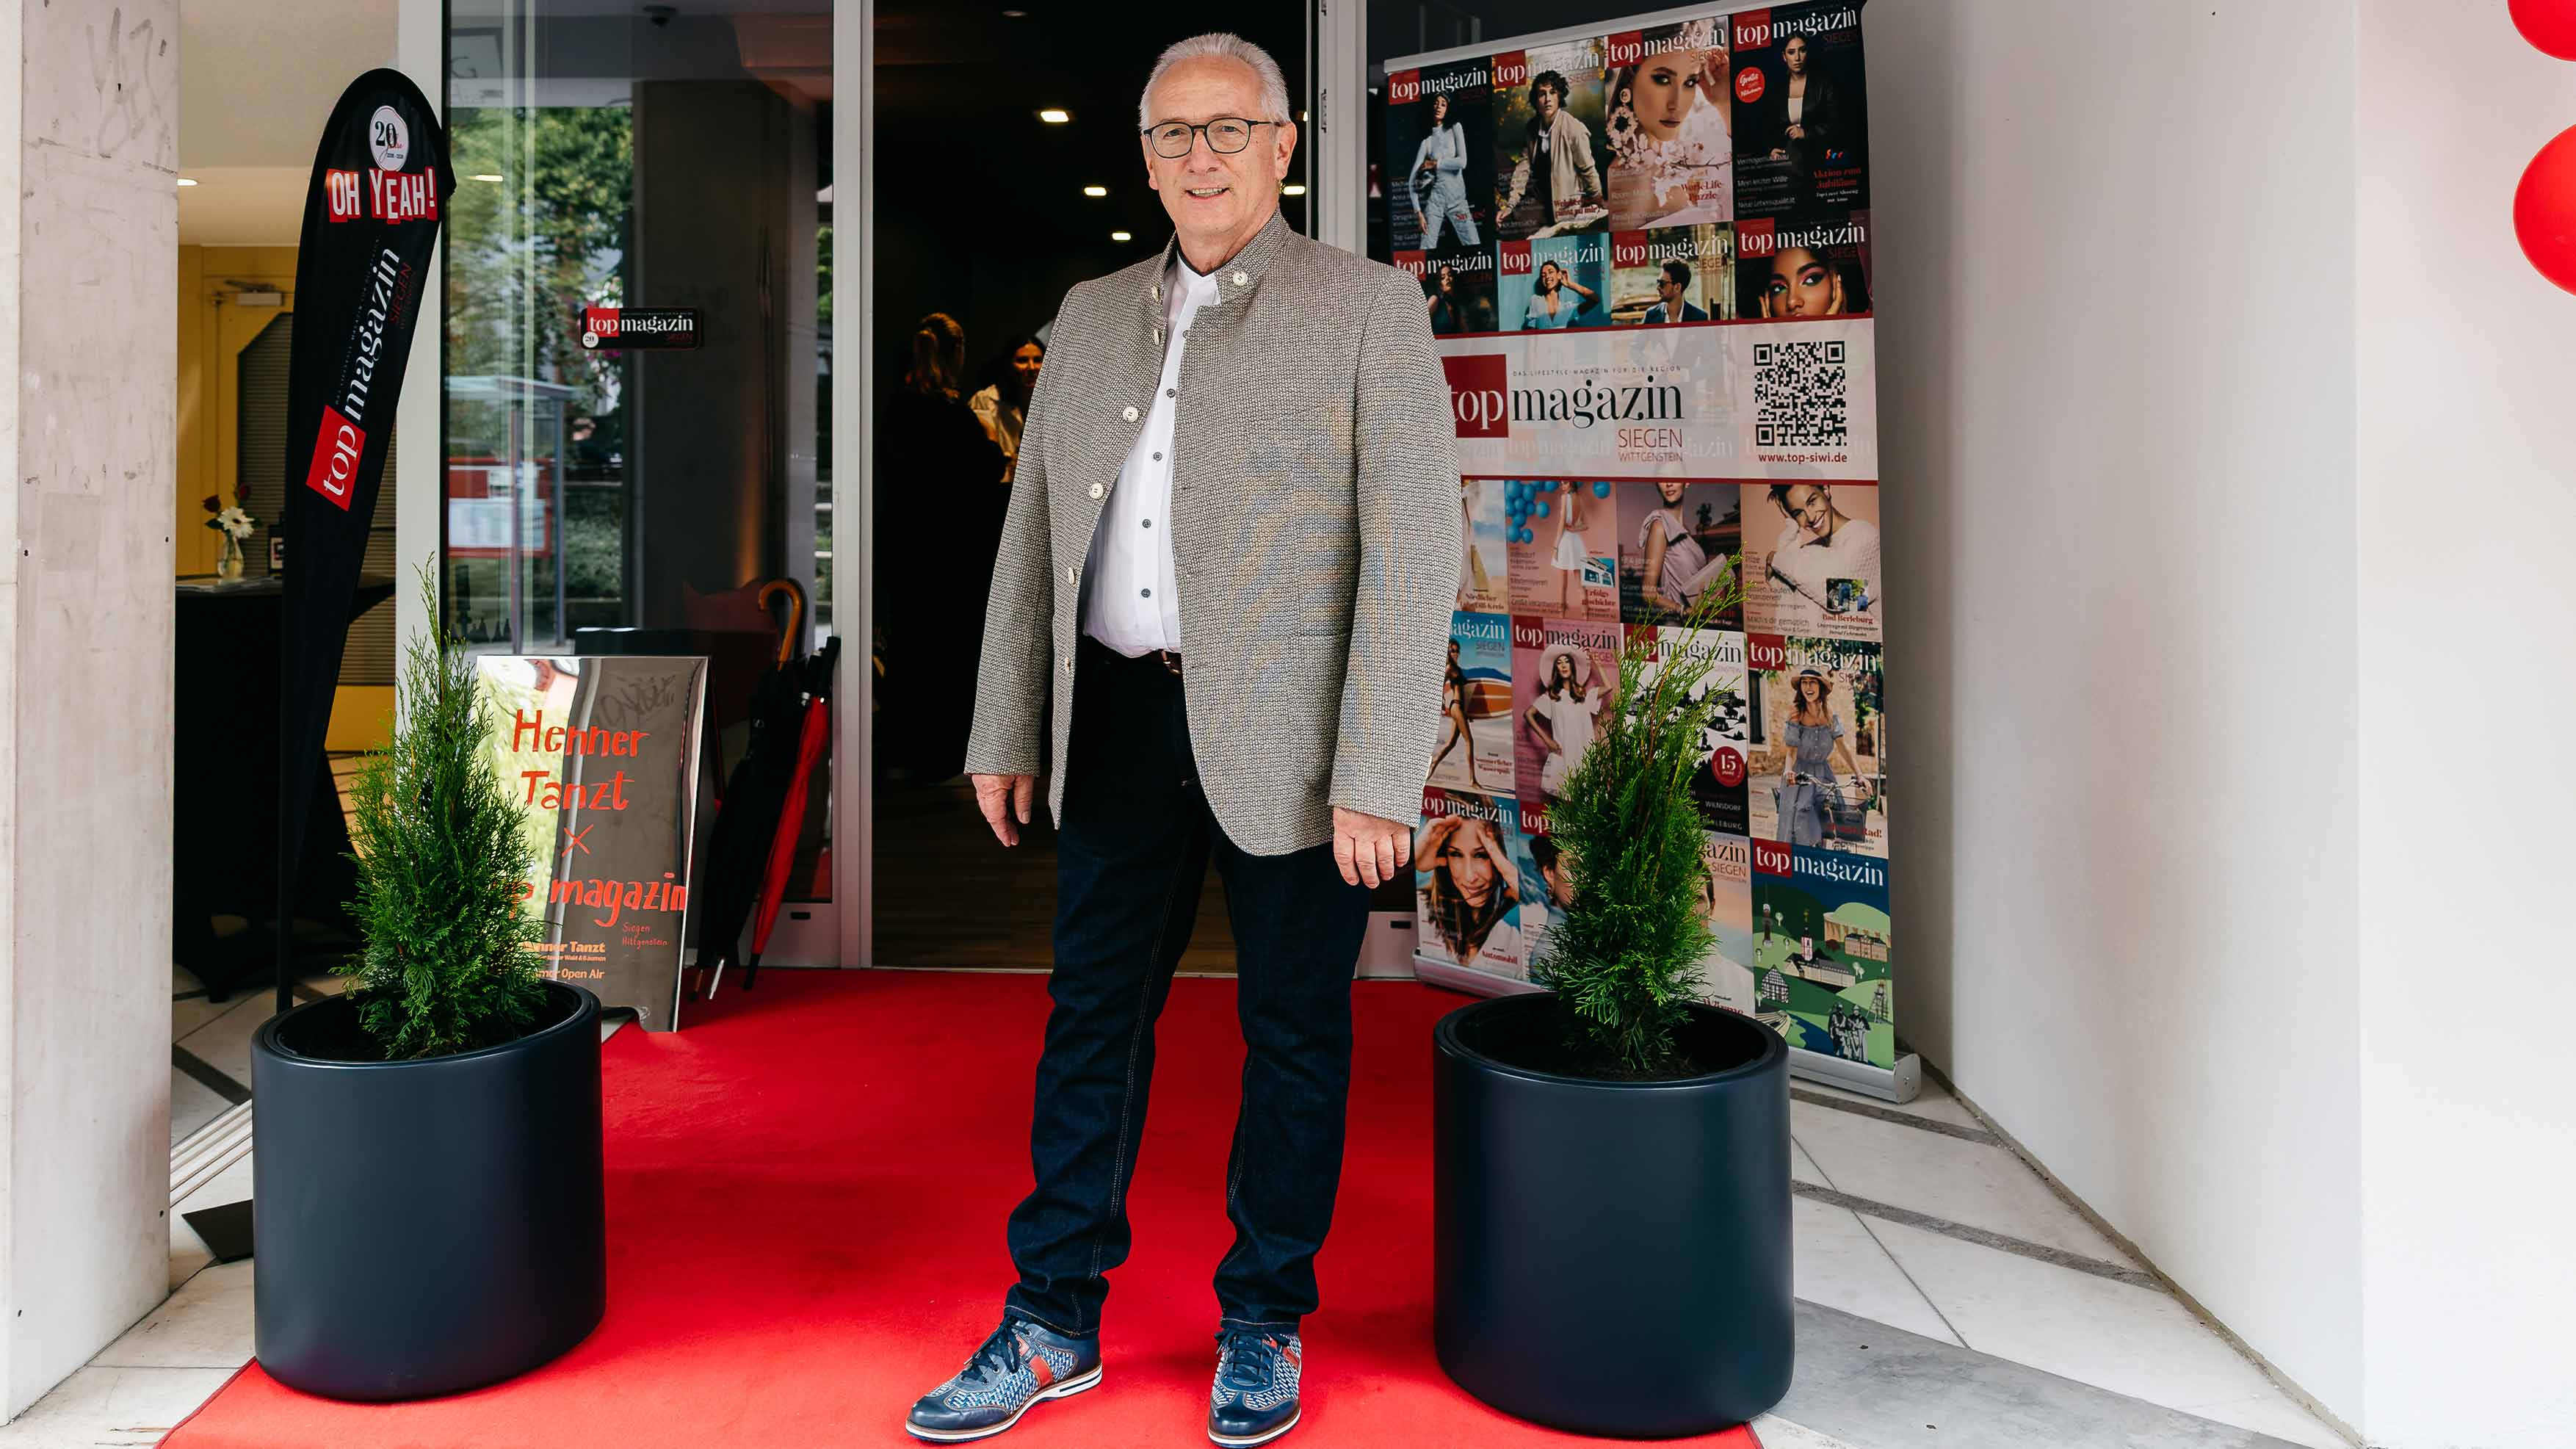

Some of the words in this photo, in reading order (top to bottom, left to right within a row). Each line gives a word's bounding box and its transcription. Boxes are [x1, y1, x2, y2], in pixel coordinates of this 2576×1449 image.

[1735, 24, 1768, 46] top
[1773, 7, 1857, 39] magazin
[1610, 43, 1640, 63] top
[1644, 27, 1726, 57] magazin
[1392, 80, 1419, 101] top
[1422, 67, 1487, 95] magazin
[1497, 62, 1525, 87] top
[375, 120, 397, 148] 20
[331, 172, 361, 215] OH
[369, 169, 435, 219] YEAH!
[1616, 242, 1645, 264] top
[1649, 234, 1728, 260] magazin
[1741, 232, 1773, 256] top
[1776, 223, 1866, 249] magazin
[1396, 258, 1425, 278] top
[1427, 251, 1492, 275] magazin
[1502, 250, 1531, 275] top
[1533, 244, 1605, 267] magazin
[589, 317, 618, 335] top
[621, 315, 693, 334] magazin
[323, 424, 360, 496] top
[344, 248, 400, 421] magazin
[1511, 375, 1686, 429] magazin
[1618, 428, 1683, 448] SIEGEN
[1618, 451, 1683, 463] WITTGENSTEIN
[1758, 452, 1848, 465] www.top-siwi.de
[1450, 618, 1505, 640] agazin
[1822, 613, 1837, 621] Bad
[1837, 614, 1874, 624] Berleburg
[1515, 624, 1542, 647] top
[1545, 628, 1617, 650] magazin
[1751, 641, 1783, 667] top
[1787, 641, 1877, 672] magazin
[512, 709, 651, 758] Henner
[1721, 754, 1737, 770] 15
[521, 770, 635, 811] Tanzt
[1446, 797, 1513, 825] magazin
[1522, 811, 1549, 833] top
[1699, 841, 1746, 864] azin
[1756, 846, 1790, 872] top
[1793, 854, 1884, 886] magazin
[1712, 862, 1746, 878] SIEGEN
[550, 872, 687, 928] magazin
[570, 941, 606, 953] Tanzt
[561, 968, 587, 980] Open
[589, 969, 605, 979] Air
